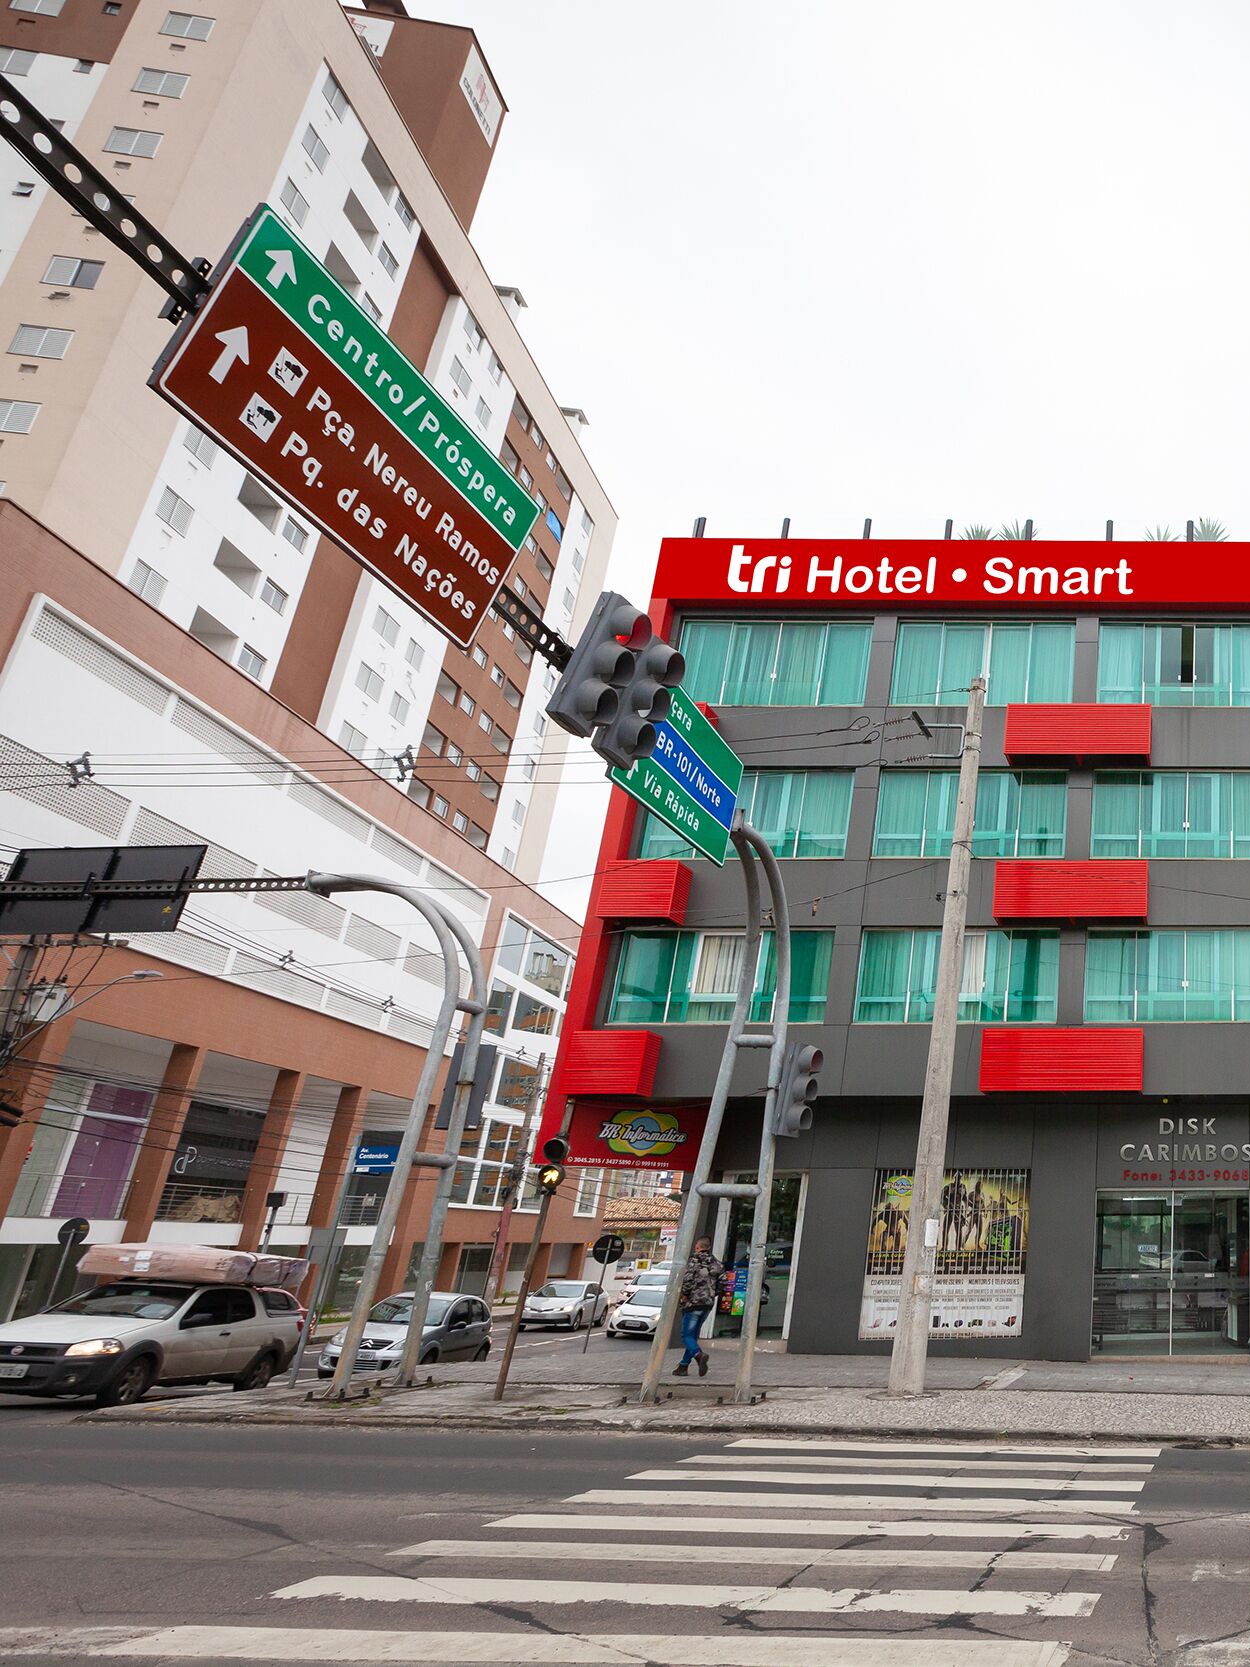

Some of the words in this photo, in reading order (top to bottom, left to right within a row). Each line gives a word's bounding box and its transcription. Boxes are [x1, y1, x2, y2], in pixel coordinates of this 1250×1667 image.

[306, 294, 517, 526] Centro/Próspera
[306, 386, 356, 453] Pça.
[363, 442, 433, 517] Nereu
[434, 512, 500, 585] Ramos
[280, 432, 324, 489] Pq.
[337, 488, 386, 540] das
[393, 533, 477, 620] Nações
[727, 545, 792, 593] tri
[807, 555, 937, 594] Hotel
[983, 557, 1134, 595] Smart
[656, 730, 721, 807] BR-101/Norte
[643, 769, 661, 799] Via
[665, 789, 700, 832] Rápida
[599, 1123, 620, 1139] BR
[622, 1124, 685, 1142] Informática
[1158, 1117, 1217, 1135] DISK
[1122, 1169, 1163, 1181] Fone:
[1169, 1169, 1250, 1182] 3433-9068
